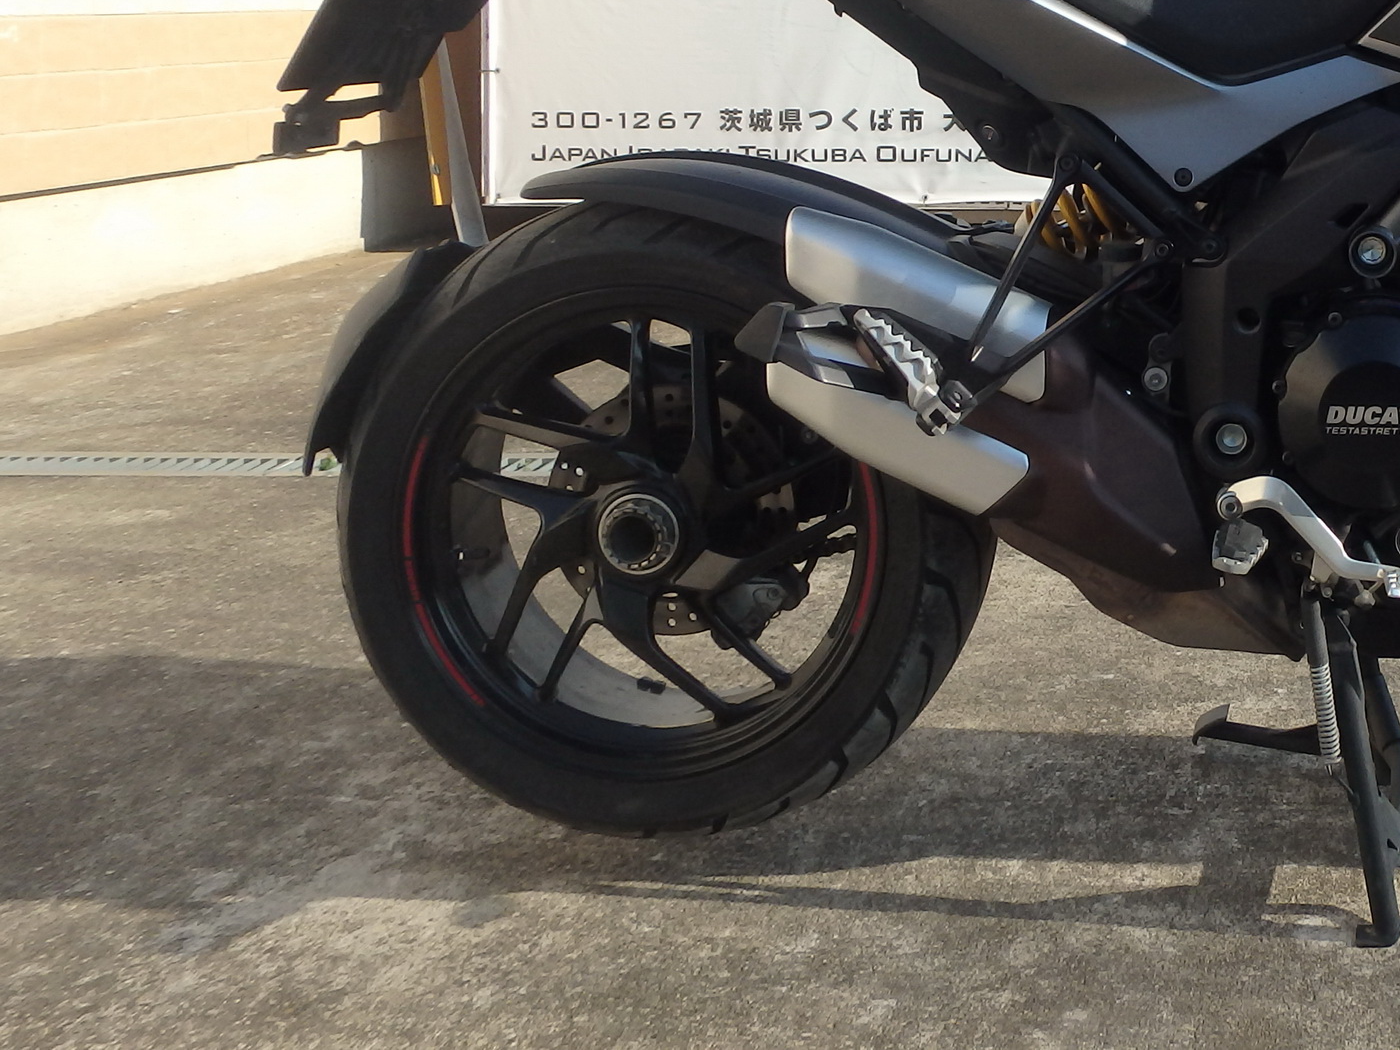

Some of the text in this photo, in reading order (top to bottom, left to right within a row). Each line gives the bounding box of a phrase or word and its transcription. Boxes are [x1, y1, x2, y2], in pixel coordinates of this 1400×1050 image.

[531, 111, 702, 130] 300-1267
[719, 108, 924, 133] 茨城県つくば市
[531, 144, 617, 162] JAPAN
